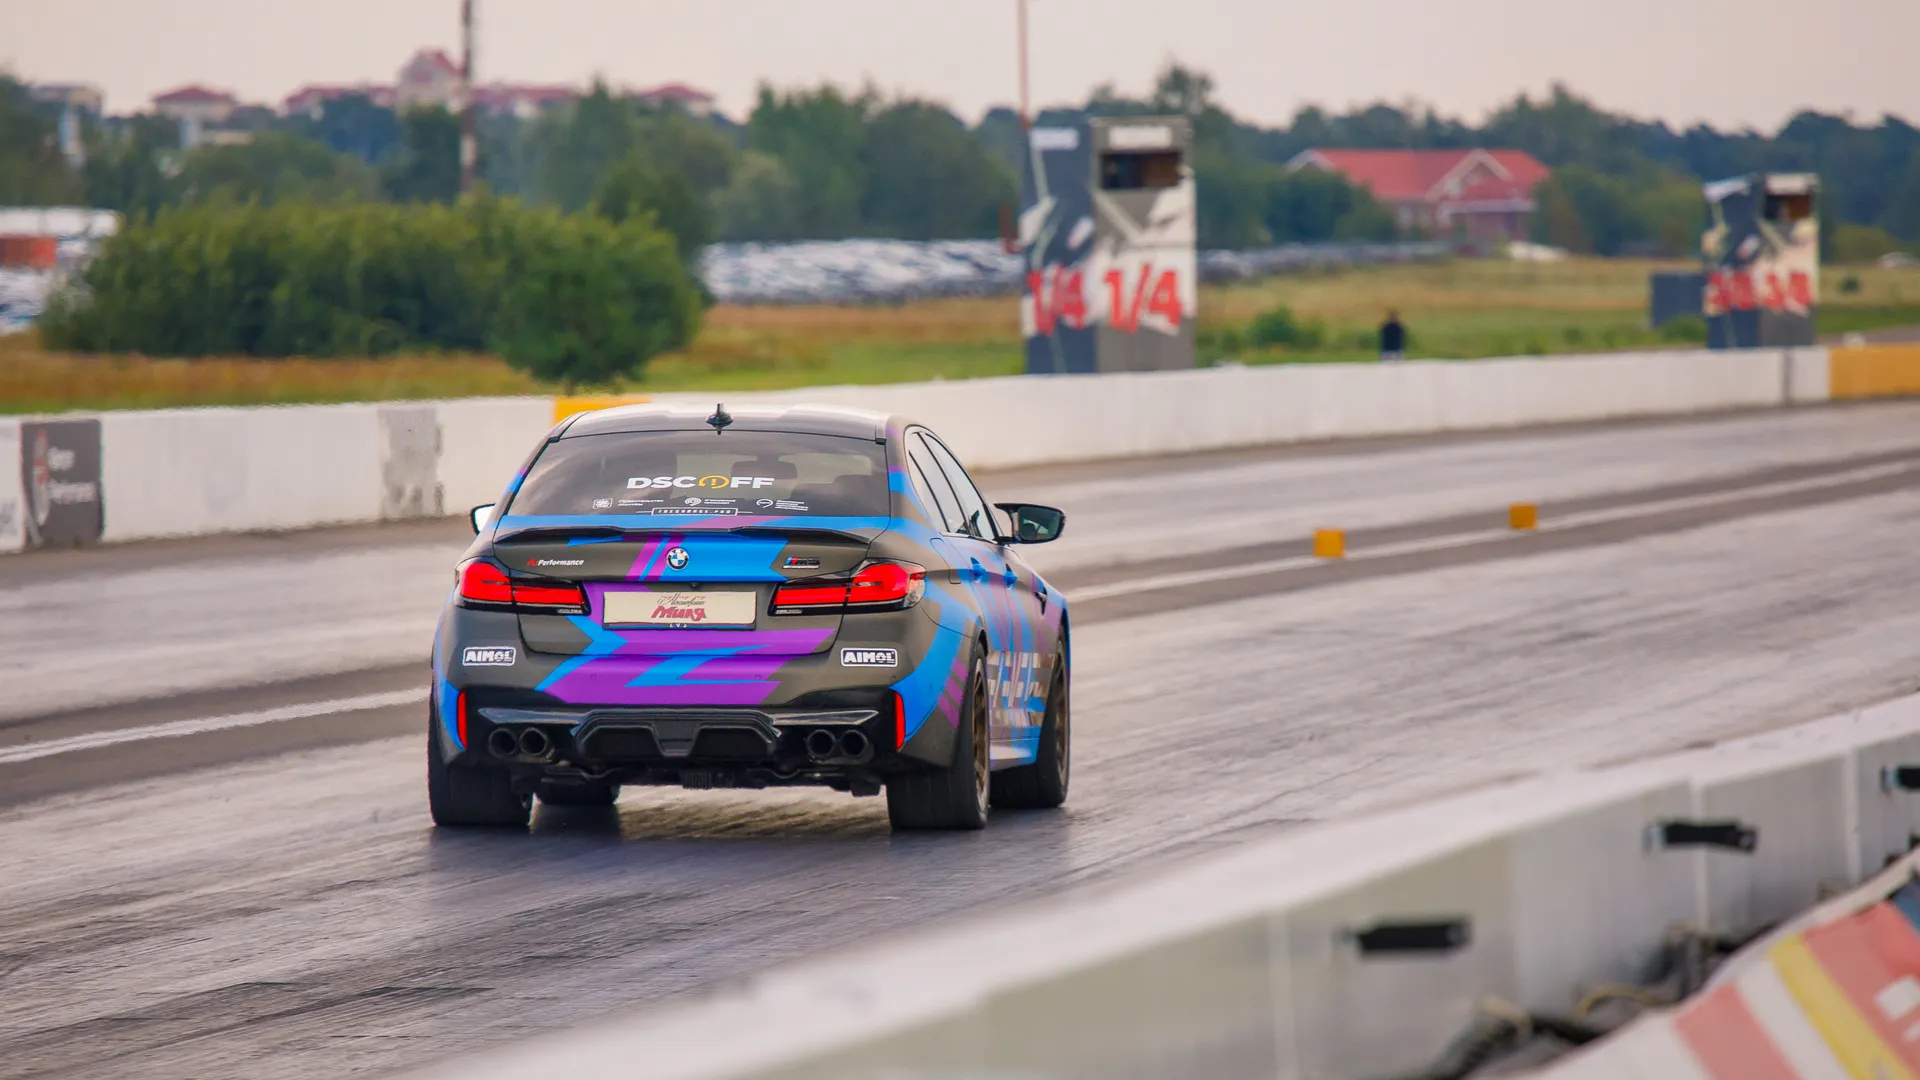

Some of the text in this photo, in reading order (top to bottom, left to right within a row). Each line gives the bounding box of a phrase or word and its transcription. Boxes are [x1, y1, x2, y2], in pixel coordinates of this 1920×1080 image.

[1026, 263, 1087, 336] 1/4
[1103, 262, 1182, 335] 1/4
[651, 606, 707, 621] Миля
[465, 650, 513, 662] AIMOL
[844, 651, 895, 663] AIMOL
